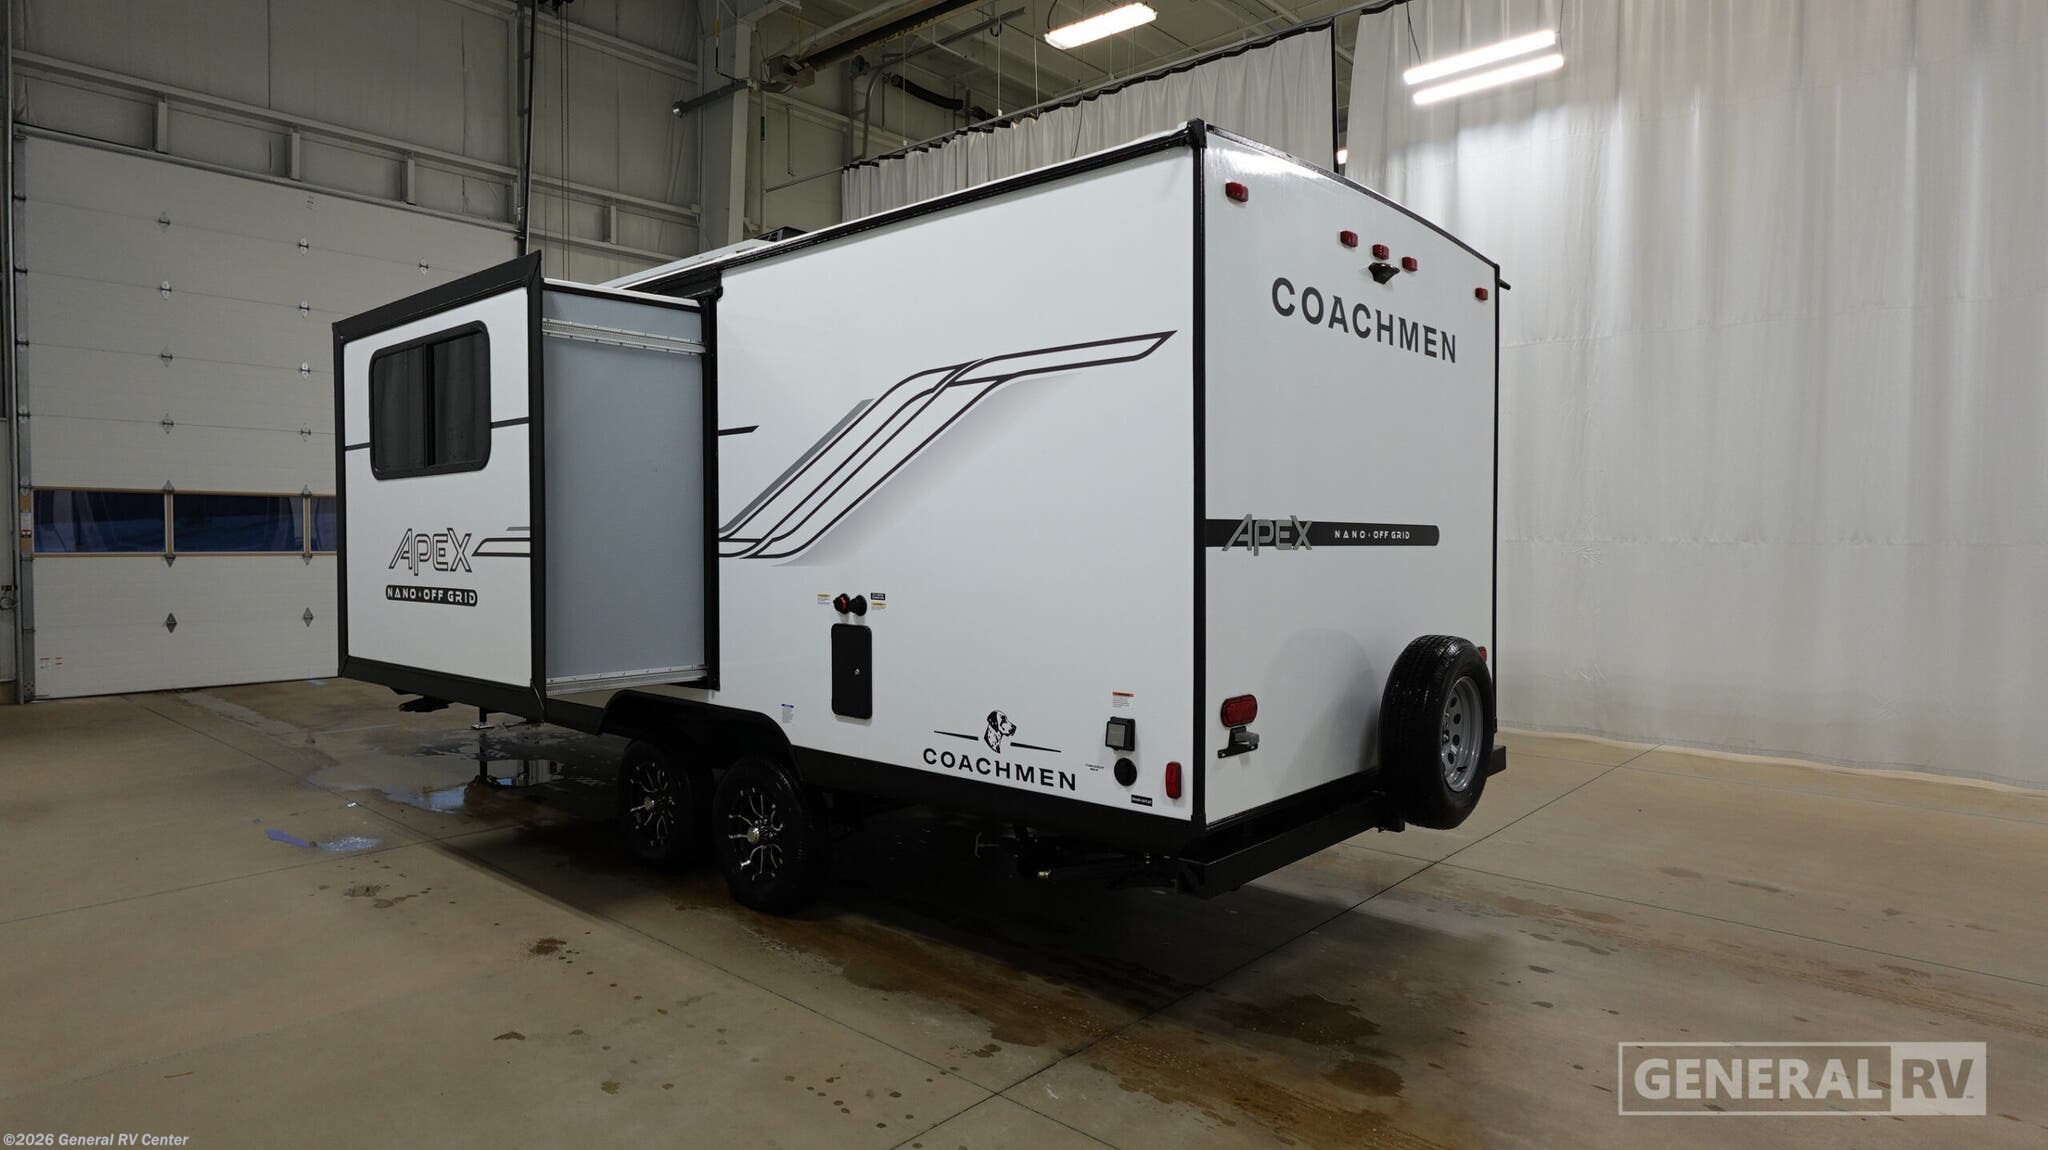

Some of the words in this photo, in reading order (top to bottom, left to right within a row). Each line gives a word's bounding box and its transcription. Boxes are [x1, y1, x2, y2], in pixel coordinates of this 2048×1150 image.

[1271, 276, 1456, 364] COACHMEN
[389, 528, 472, 576] APEX
[1221, 513, 1313, 557] APEX
[1391, 531, 1410, 540] GRID
[447, 591, 476, 604] GRID
[923, 747, 1076, 791] COACHMEN
